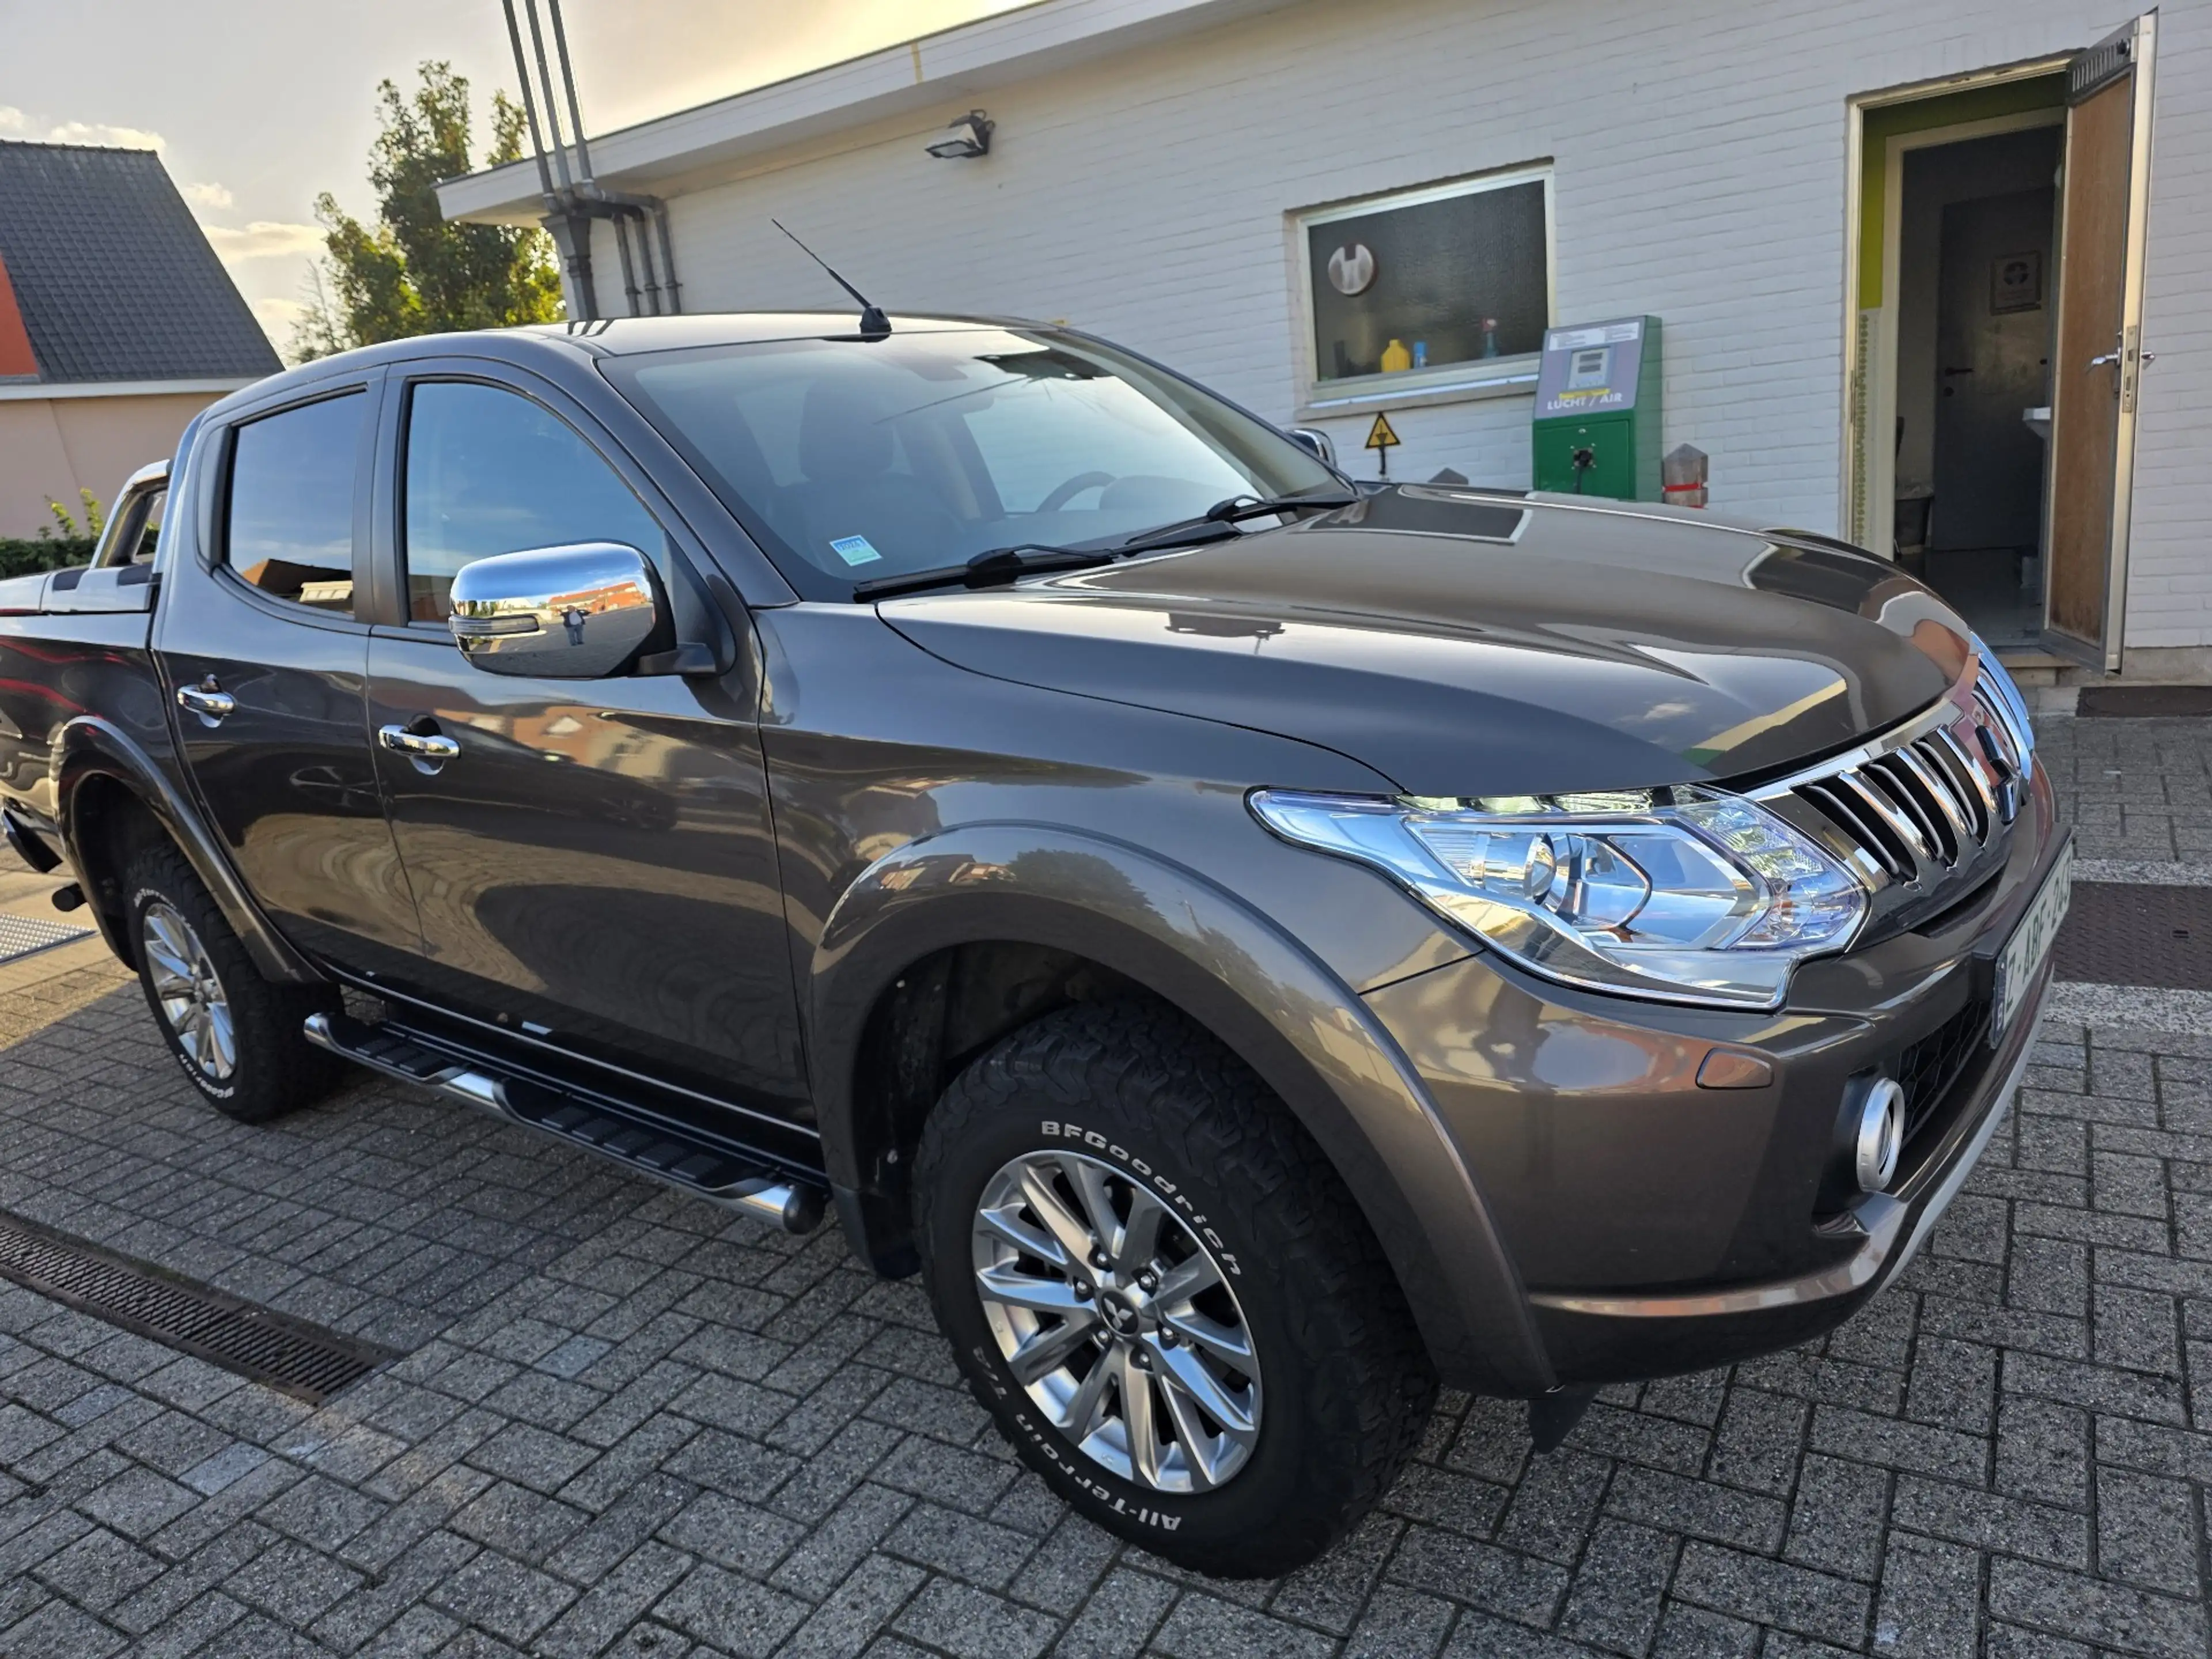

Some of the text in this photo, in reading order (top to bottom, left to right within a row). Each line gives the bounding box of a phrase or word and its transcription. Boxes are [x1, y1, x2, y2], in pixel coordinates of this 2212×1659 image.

[1547, 396, 1587, 410] LUCHT
[1600, 392, 1623, 404] AIR
[1041, 1120, 1241, 1275] BFGoodrich
[972, 1346, 1181, 1531] All-Terrain T/A
